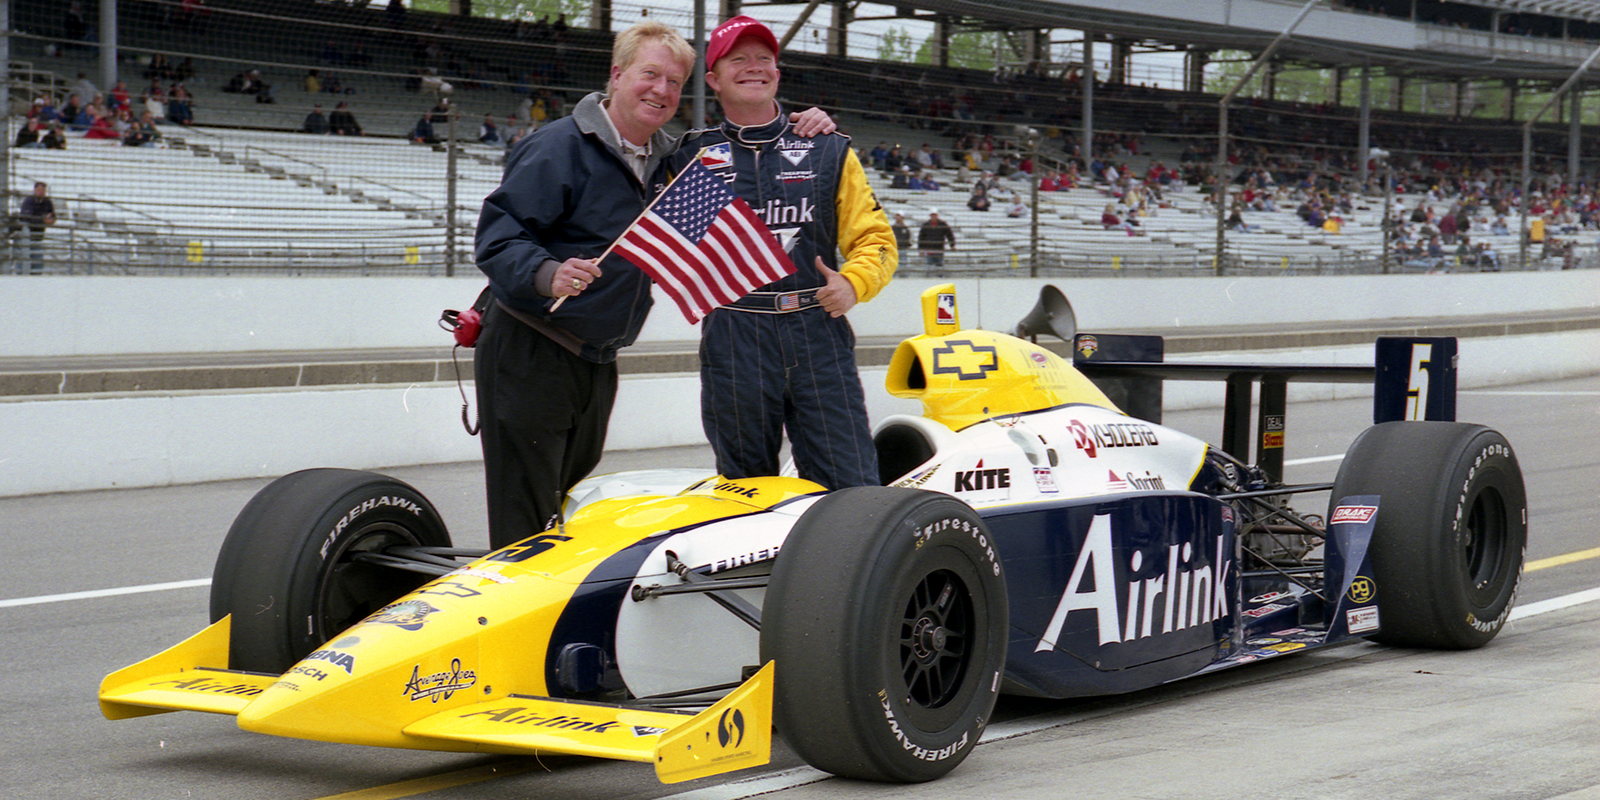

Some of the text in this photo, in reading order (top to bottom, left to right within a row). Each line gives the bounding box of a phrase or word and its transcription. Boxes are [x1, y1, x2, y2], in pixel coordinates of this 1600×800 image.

[774, 137, 815, 149] Airlink
[745, 197, 815, 225] rlink
[1405, 343, 1432, 421] 5
[1088, 423, 1159, 448] KYOCERA
[954, 468, 1011, 492] KITE
[1126, 470, 1166, 490] Sprint
[1456, 444, 1510, 521] Firestone
[1336, 508, 1373, 516] DRAKE
[319, 495, 423, 561] FIREHAWK
[486, 535, 574, 563] 5
[924, 518, 1000, 577] Firestone
[1034, 513, 1231, 653] Airlink
[1351, 580, 1370, 599] pg
[148, 677, 264, 696] Airlin
[402, 663, 451, 703] Average
[459, 707, 620, 733] Airlink
[881, 699, 968, 761] FIREHAWK
